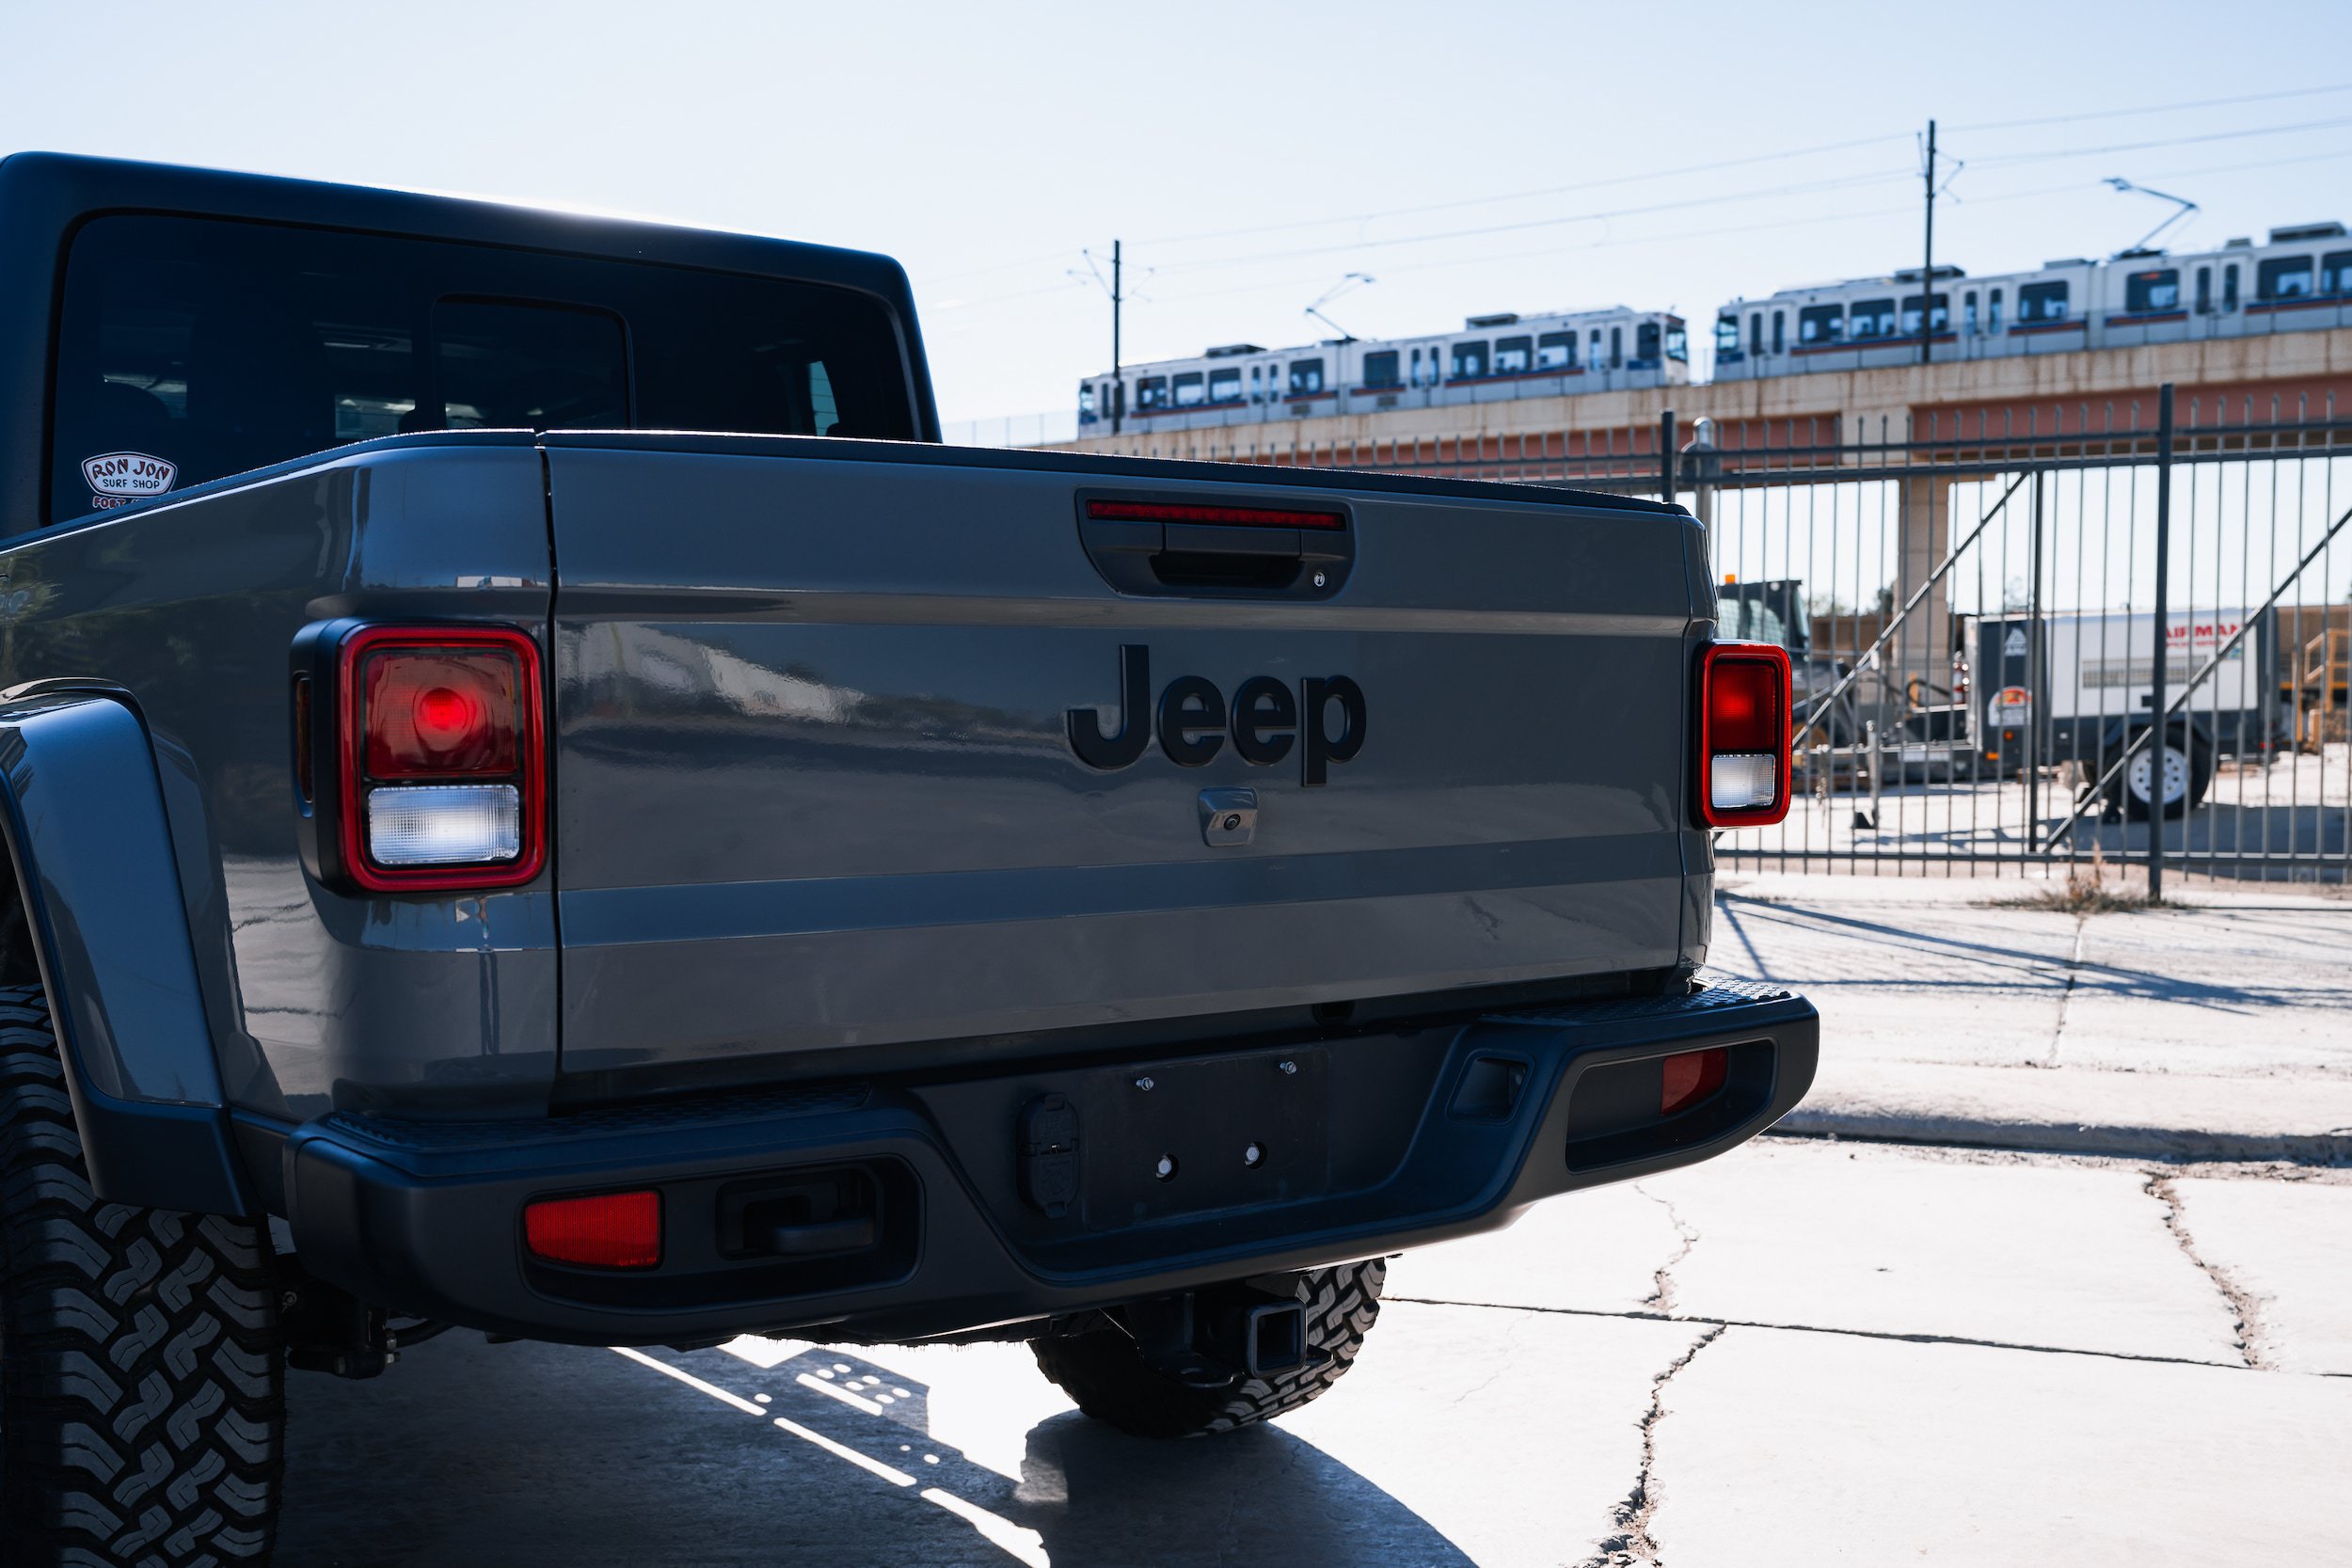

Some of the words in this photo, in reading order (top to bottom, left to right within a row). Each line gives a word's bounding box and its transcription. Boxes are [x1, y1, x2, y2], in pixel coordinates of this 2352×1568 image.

[92, 459, 128, 480] RON
[133, 461, 170, 481] JON
[103, 479, 128, 488] SURF
[133, 480, 160, 489] SHOP
[93, 496, 126, 509] FORT
[1068, 644, 1367, 787] Jeep
